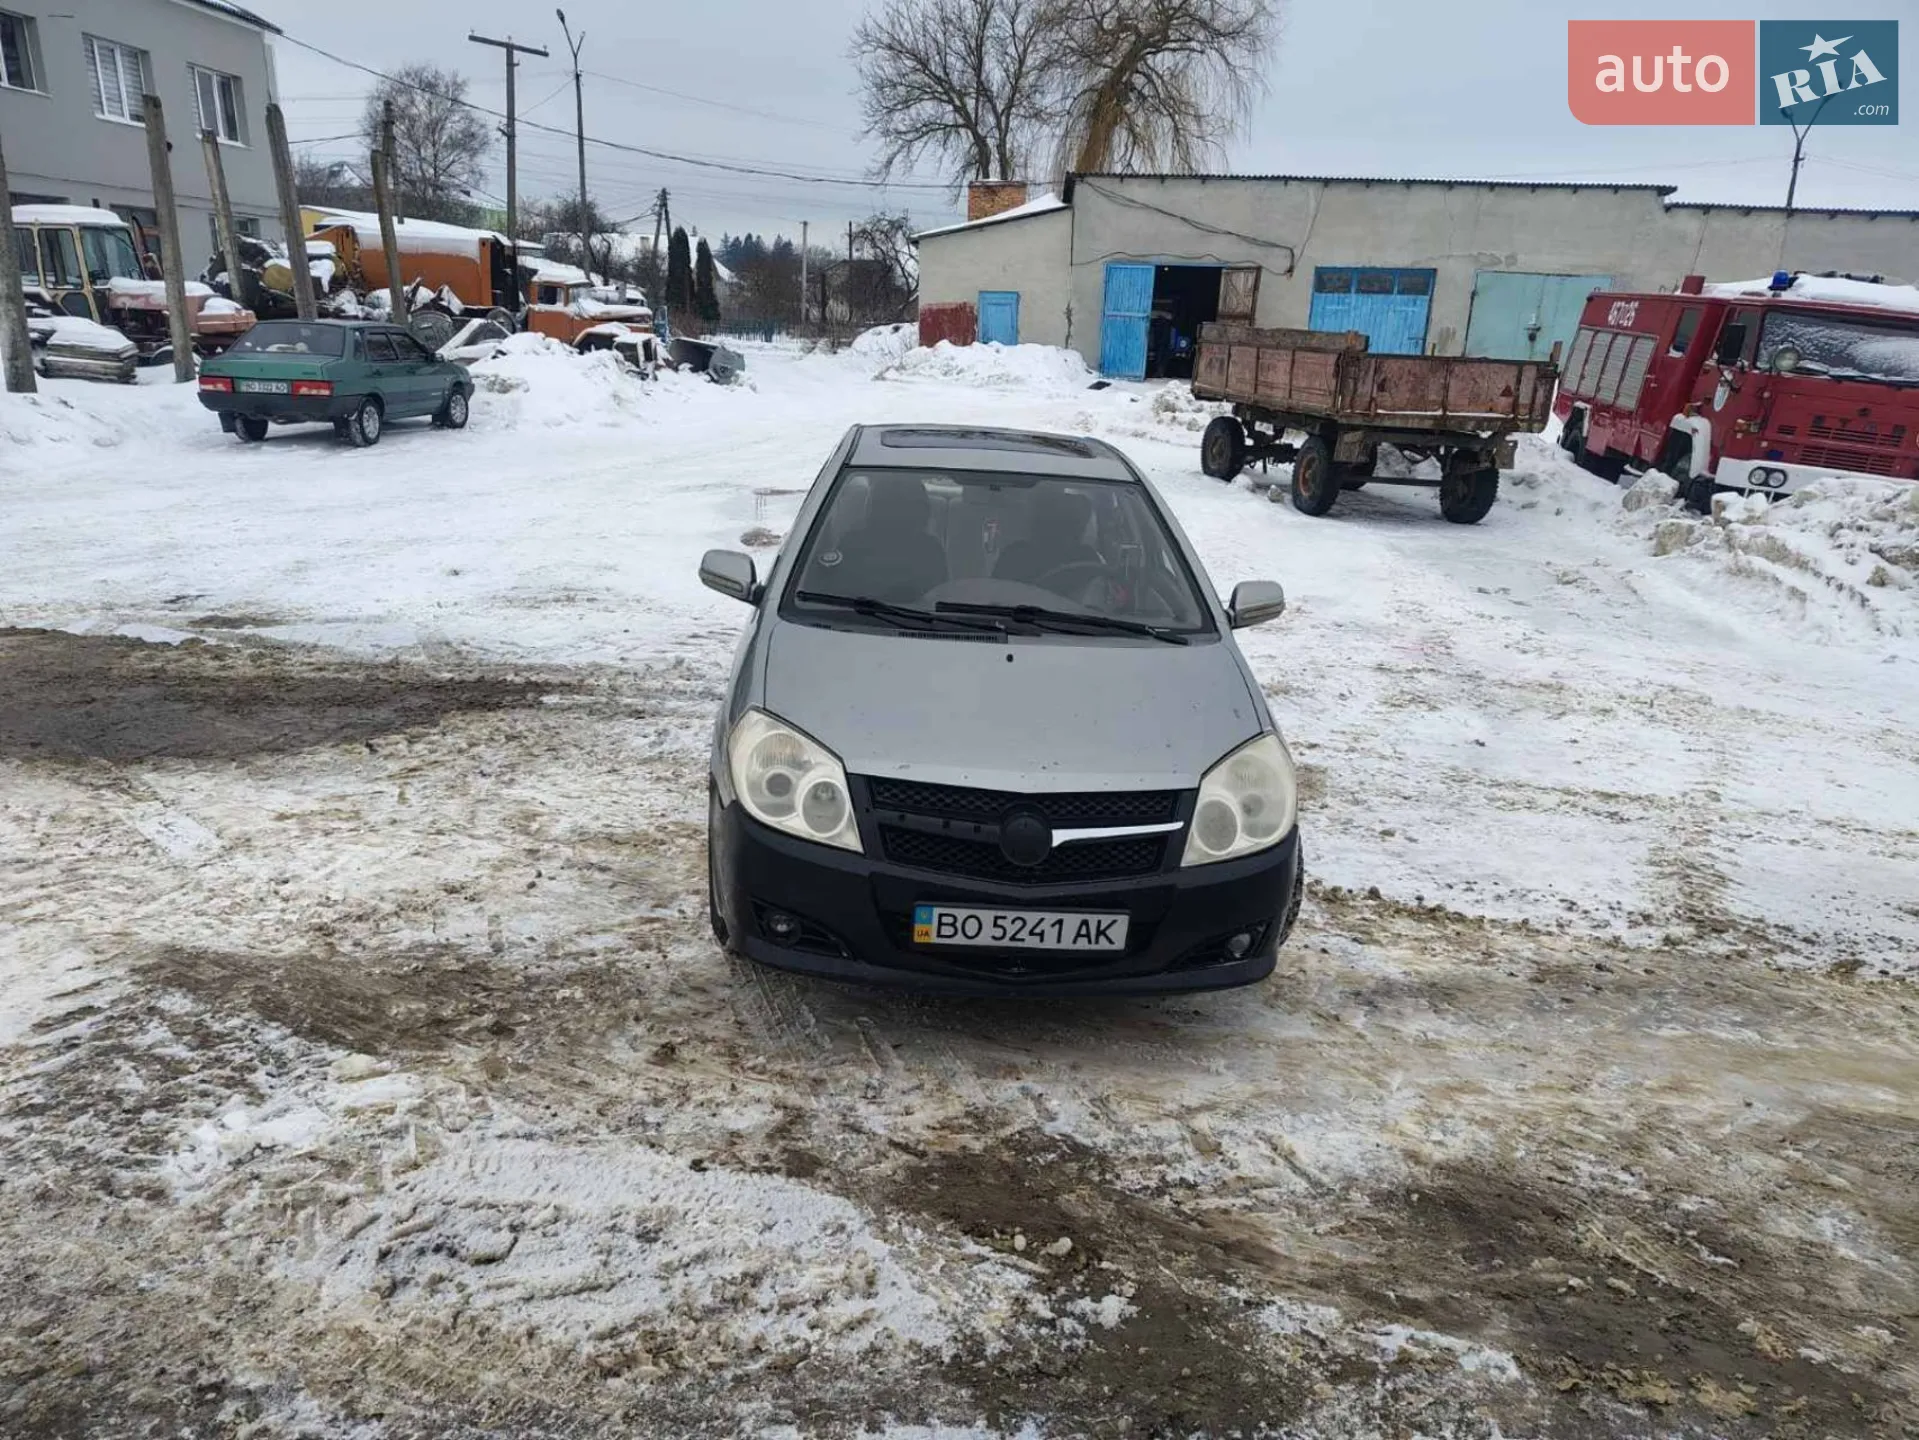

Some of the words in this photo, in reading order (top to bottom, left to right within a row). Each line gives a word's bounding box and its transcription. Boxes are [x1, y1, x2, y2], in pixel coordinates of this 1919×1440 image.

[936, 912, 983, 940] BO
[991, 915, 1064, 944] 5241
[1072, 919, 1118, 945] AK
